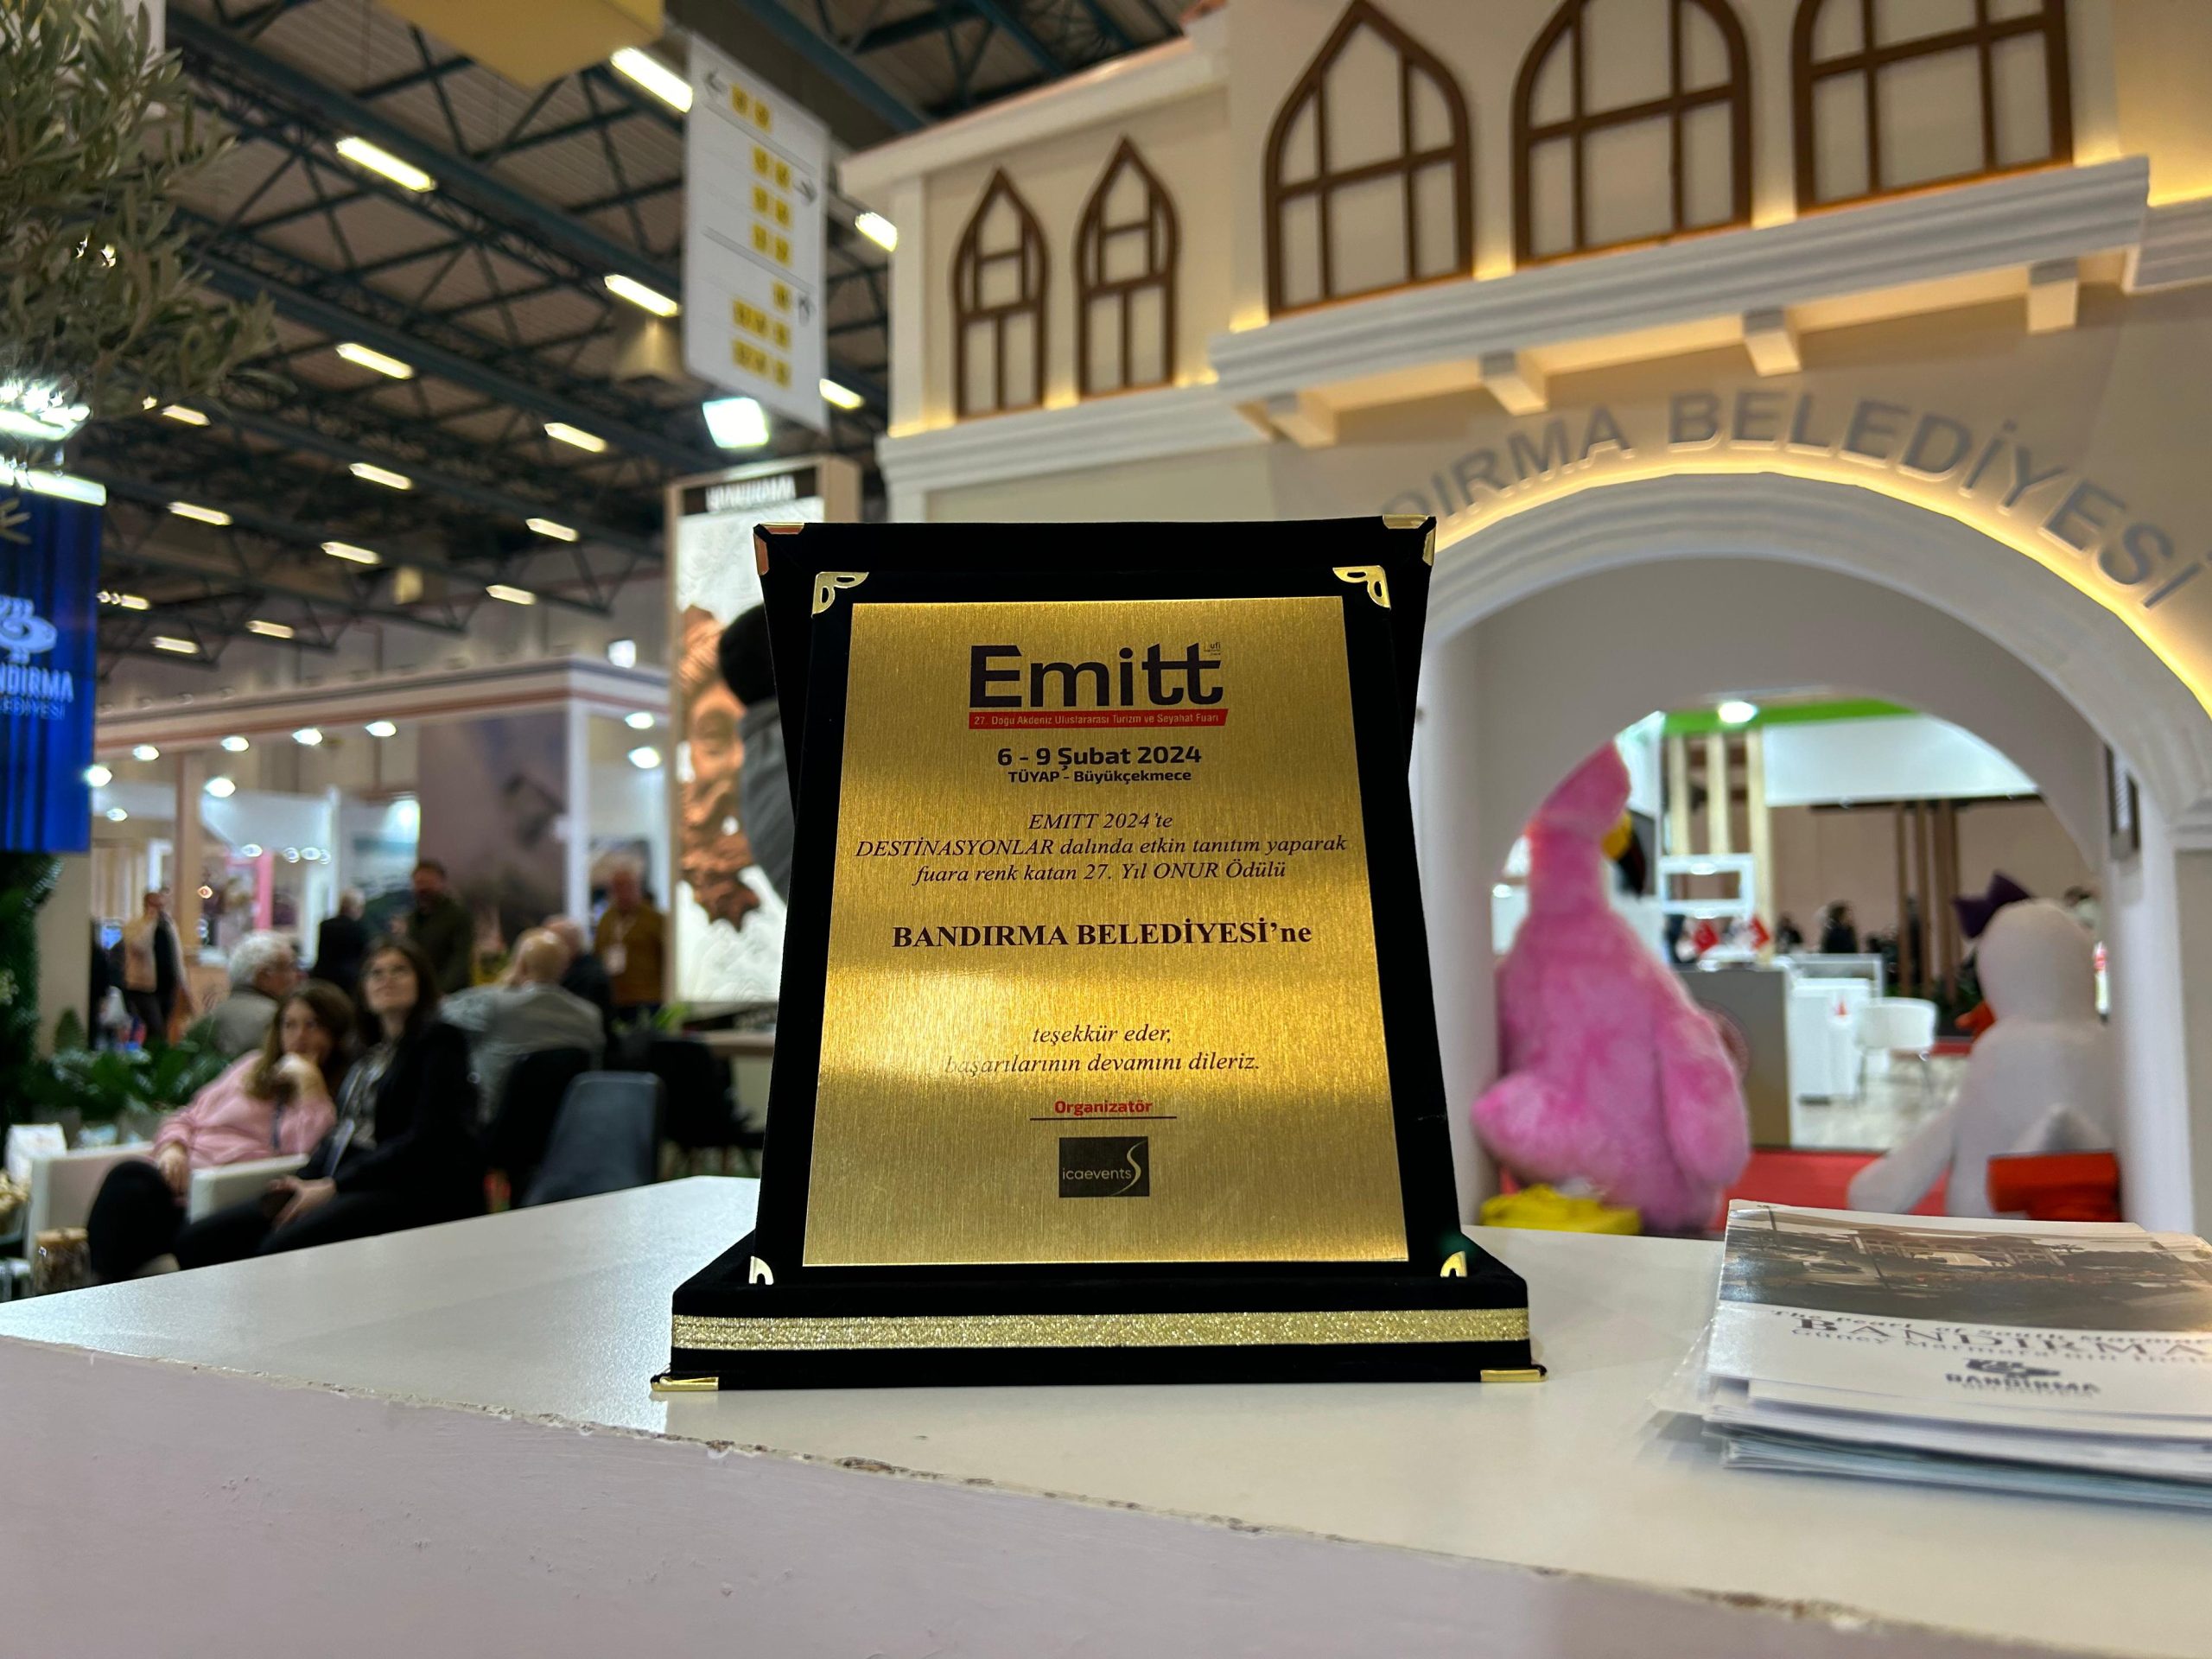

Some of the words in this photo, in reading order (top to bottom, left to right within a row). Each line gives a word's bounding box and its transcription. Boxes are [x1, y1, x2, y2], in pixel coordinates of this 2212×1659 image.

[1668, 390, 2212, 610] BELEDİYESİ
[969, 642, 1224, 709] Emitt
[1017, 715, 1052, 725] Akdeniz
[1055, 715, 1109, 725] Uluslararası
[1113, 714, 1141, 724] Turizm
[1157, 713, 1193, 725] Seyahat
[1196, 713, 1218, 723] Fuarı
[997, 747, 1013, 766] 6
[1036, 747, 1052, 766] 9
[1057, 747, 1131, 771] Şubat
[1137, 745, 1202, 765] 2024
[1007, 768, 1060, 784] TÜYAP
[1073, 769, 1192, 785] Büyükçekmece
[1027, 813, 1100, 830] EMITT
[1103, 812, 1173, 829] 2024'te
[855, 836, 1055, 857] DESTİNASYONLAR
[1059, 837, 1133, 855] dalında
[1140, 837, 1186, 854] etkin
[1192, 837, 1261, 854] tanıtım
[1264, 835, 1348, 855] yaparak
[911, 865, 969, 887] fuara
[975, 864, 1019, 881] renk
[1023, 864, 1077, 881] katan
[1083, 863, 1112, 880] 27.
[1122, 862, 1147, 880] Yıl
[1153, 861, 1220, 880] ONUR
[1225, 859, 1287, 879] Ödülü
[891, 925, 1070, 948] BANDIRMA
[1075, 917, 1313, 945] BELEDİYESİ'ne
[1032, 1024, 1118, 1046] teşekkür
[1123, 1023, 1173, 1044] eder,
[944, 1053, 1081, 1077] başarılarının
[1087, 1052, 1182, 1072] devamını
[1188, 1052, 1261, 1071] dileriz.
[1053, 1099, 1154, 1116] Organizatör
[1062, 1167, 1132, 1181] icaevents
[1795, 1318, 2211, 1356] BANDIRMA
